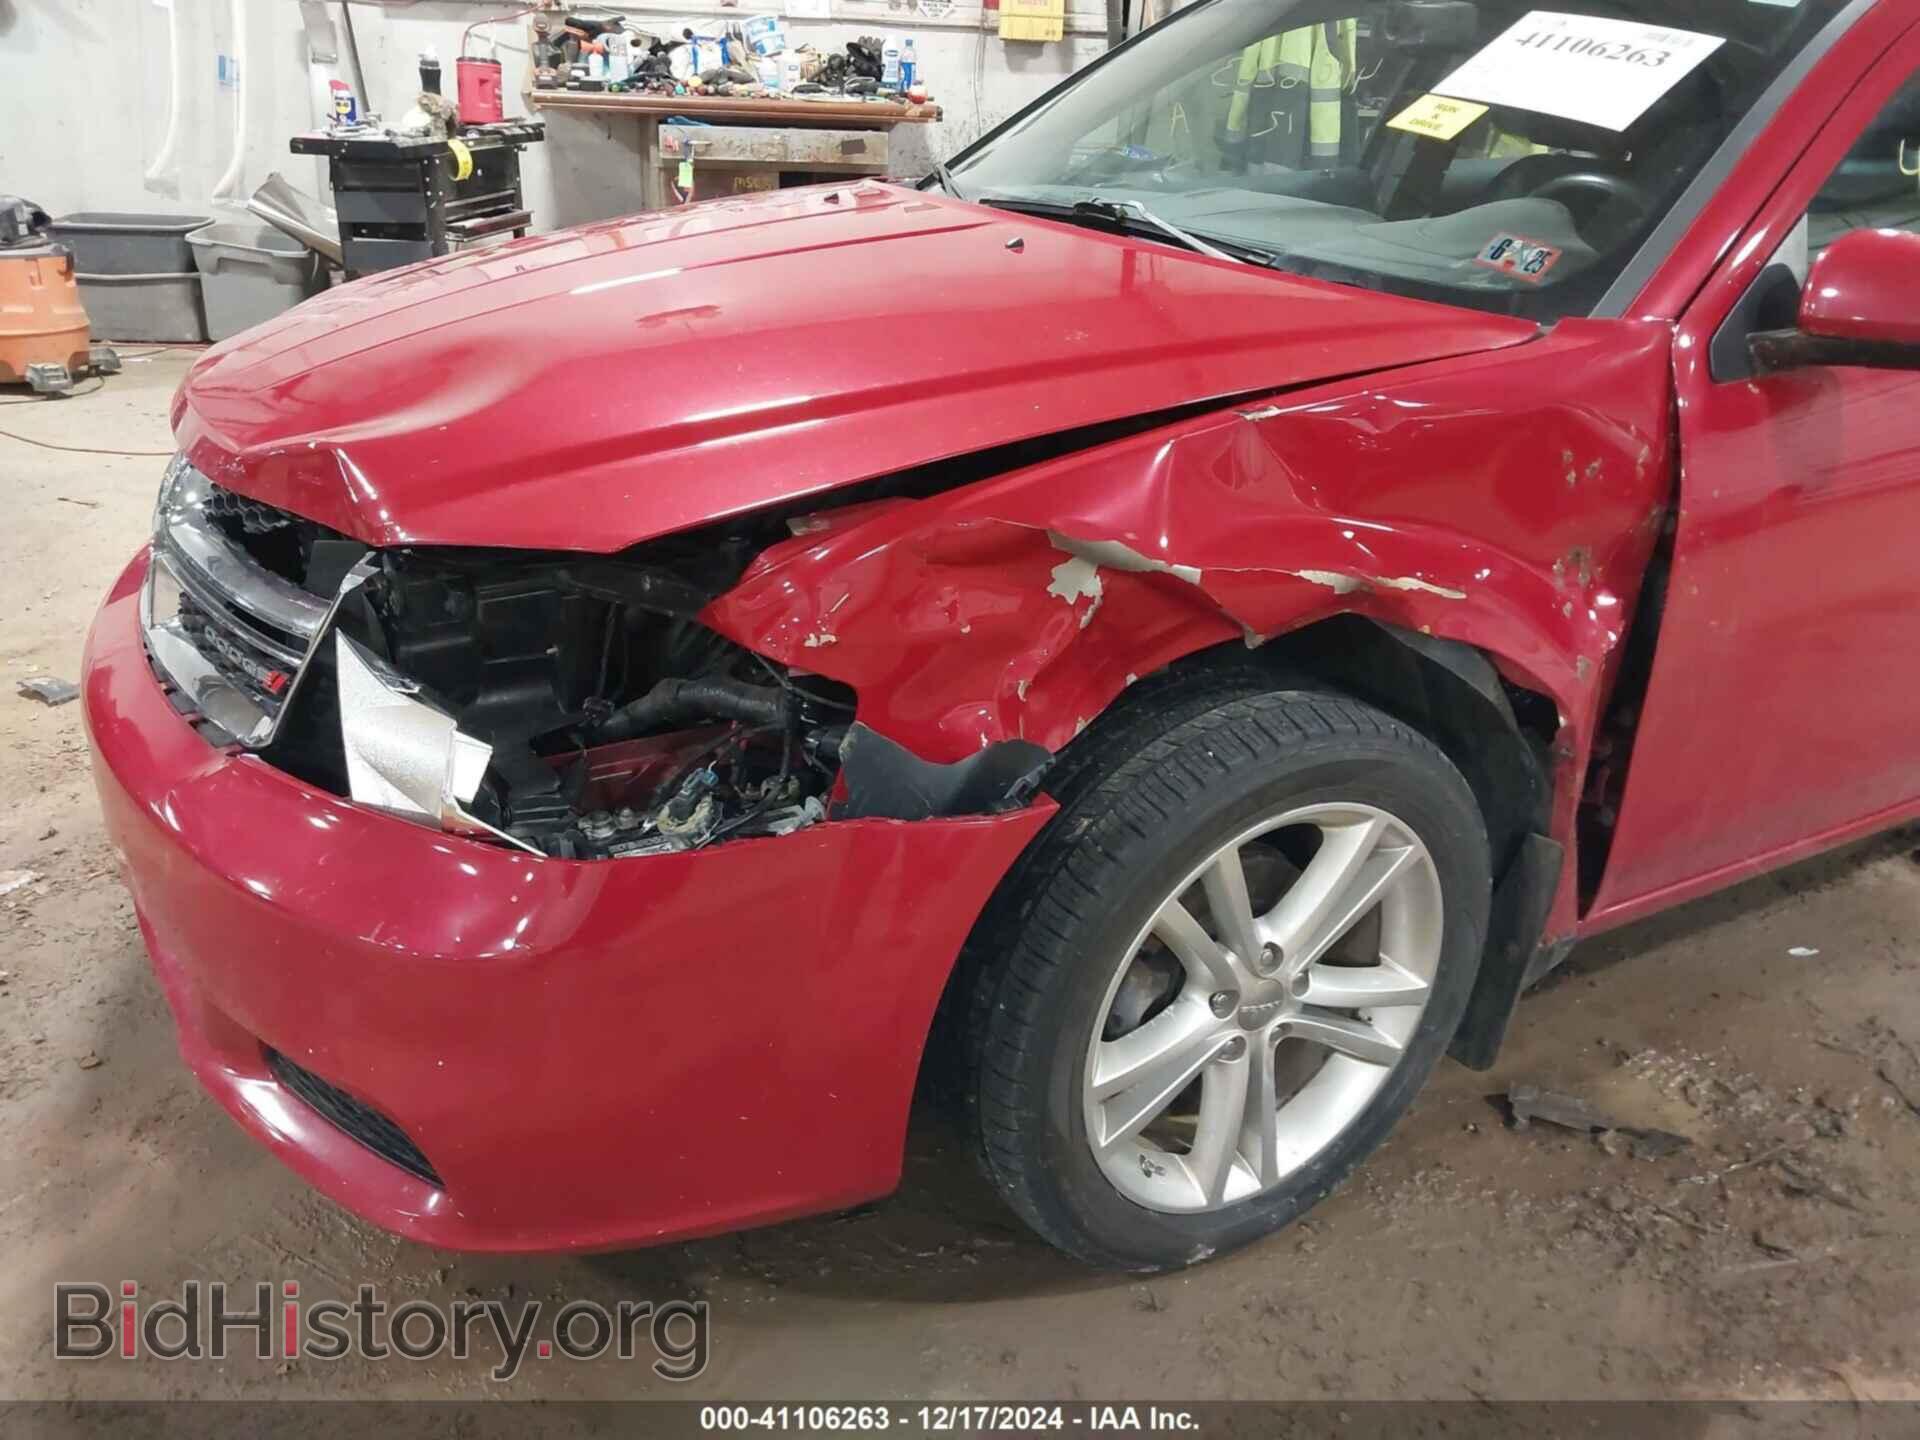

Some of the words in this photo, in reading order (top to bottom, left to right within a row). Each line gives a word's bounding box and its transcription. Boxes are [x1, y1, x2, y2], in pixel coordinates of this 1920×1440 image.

[1514, 31, 1671, 67] 41106263
[1490, 238, 1513, 260] 6
[1523, 249, 1553, 274] 25
